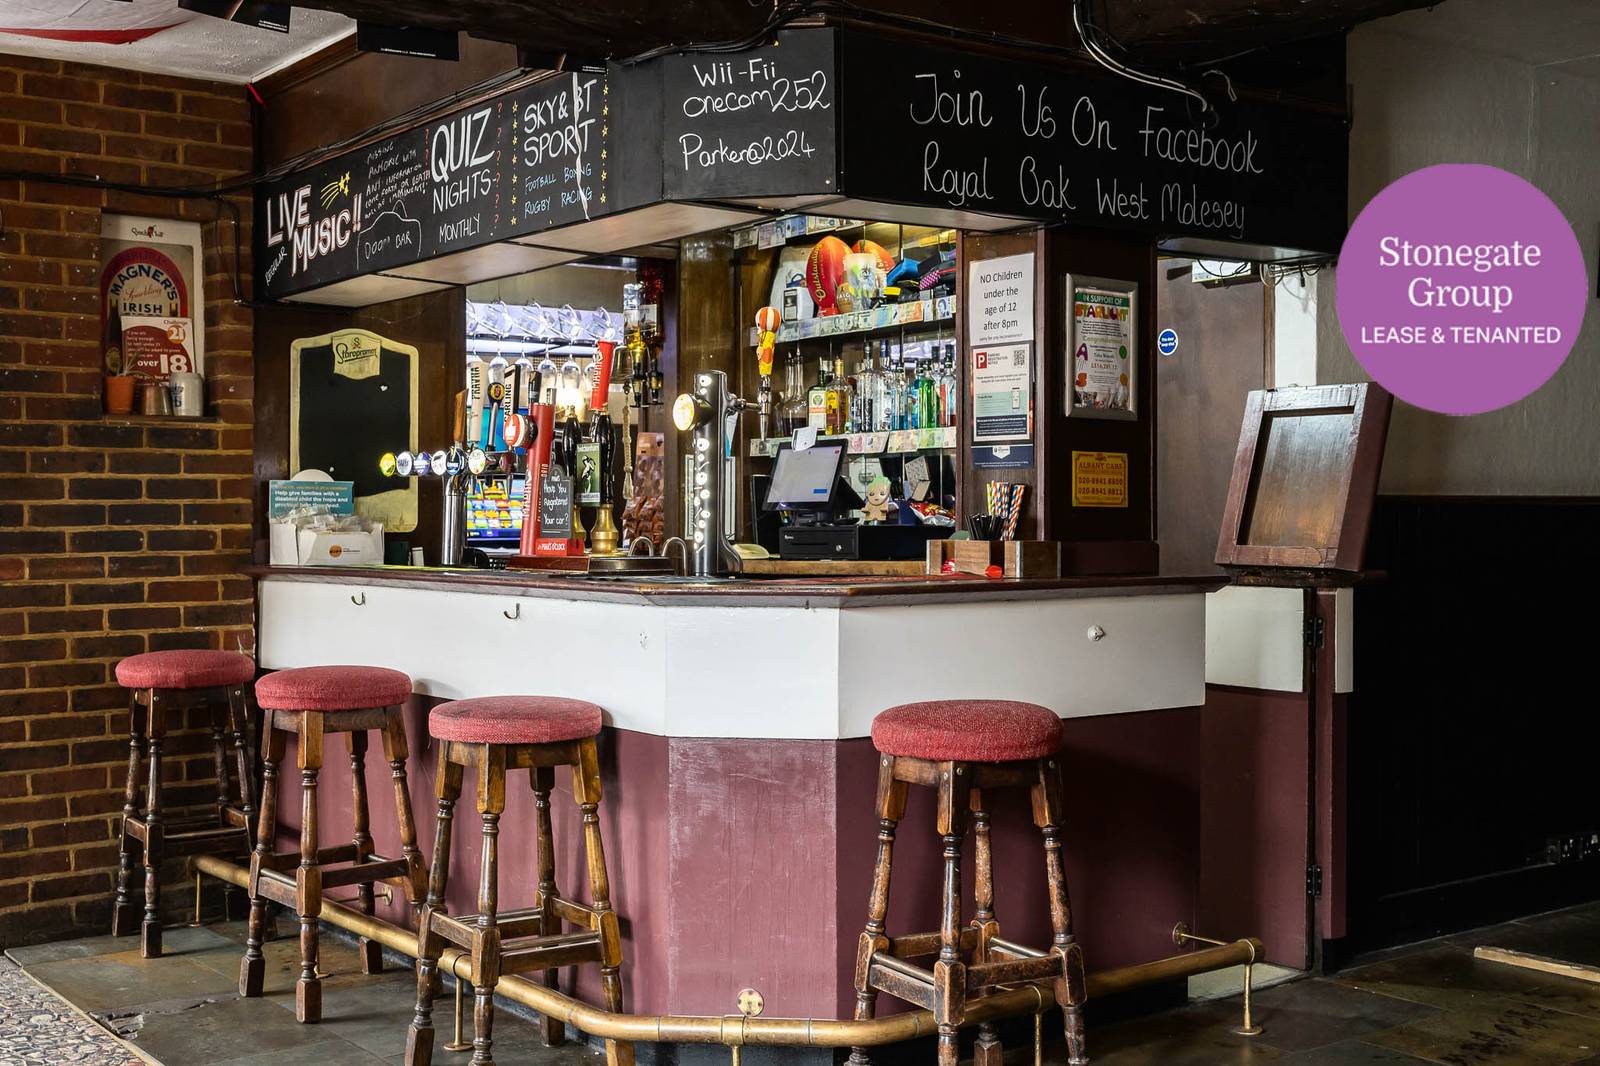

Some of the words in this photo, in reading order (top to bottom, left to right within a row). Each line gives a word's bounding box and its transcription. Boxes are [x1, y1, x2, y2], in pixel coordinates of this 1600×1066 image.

[910, 70, 993, 127] Join
[1017, 84, 1056, 138] Us
[1072, 96, 1117, 150] On
[1138, 106, 1264, 174] Facebook
[430, 107, 496, 183] QUIZ
[924, 140, 993, 206] Royal
[1019, 155, 1076, 211] Oak
[1097, 178, 1150, 220] West
[267, 184, 312, 248] LIVE
[524, 197, 551, 219] RUGBY
[439, 213, 482, 243] MONTHLY
[980, 273, 991, 284] NO
[992, 270, 1023, 282] Children
[983, 288, 1004, 299] under
[1006, 286, 1018, 296] the
[122, 302, 163, 314] IRISH
[984, 305, 997, 316] age
[998, 302, 1006, 313] of
[1008, 302, 1017, 312] 12
[983, 320, 1000, 331] after
[1001, 319, 1018, 330] 8pm
[137, 359, 159, 367] over
[160, 354, 188, 374] 18
